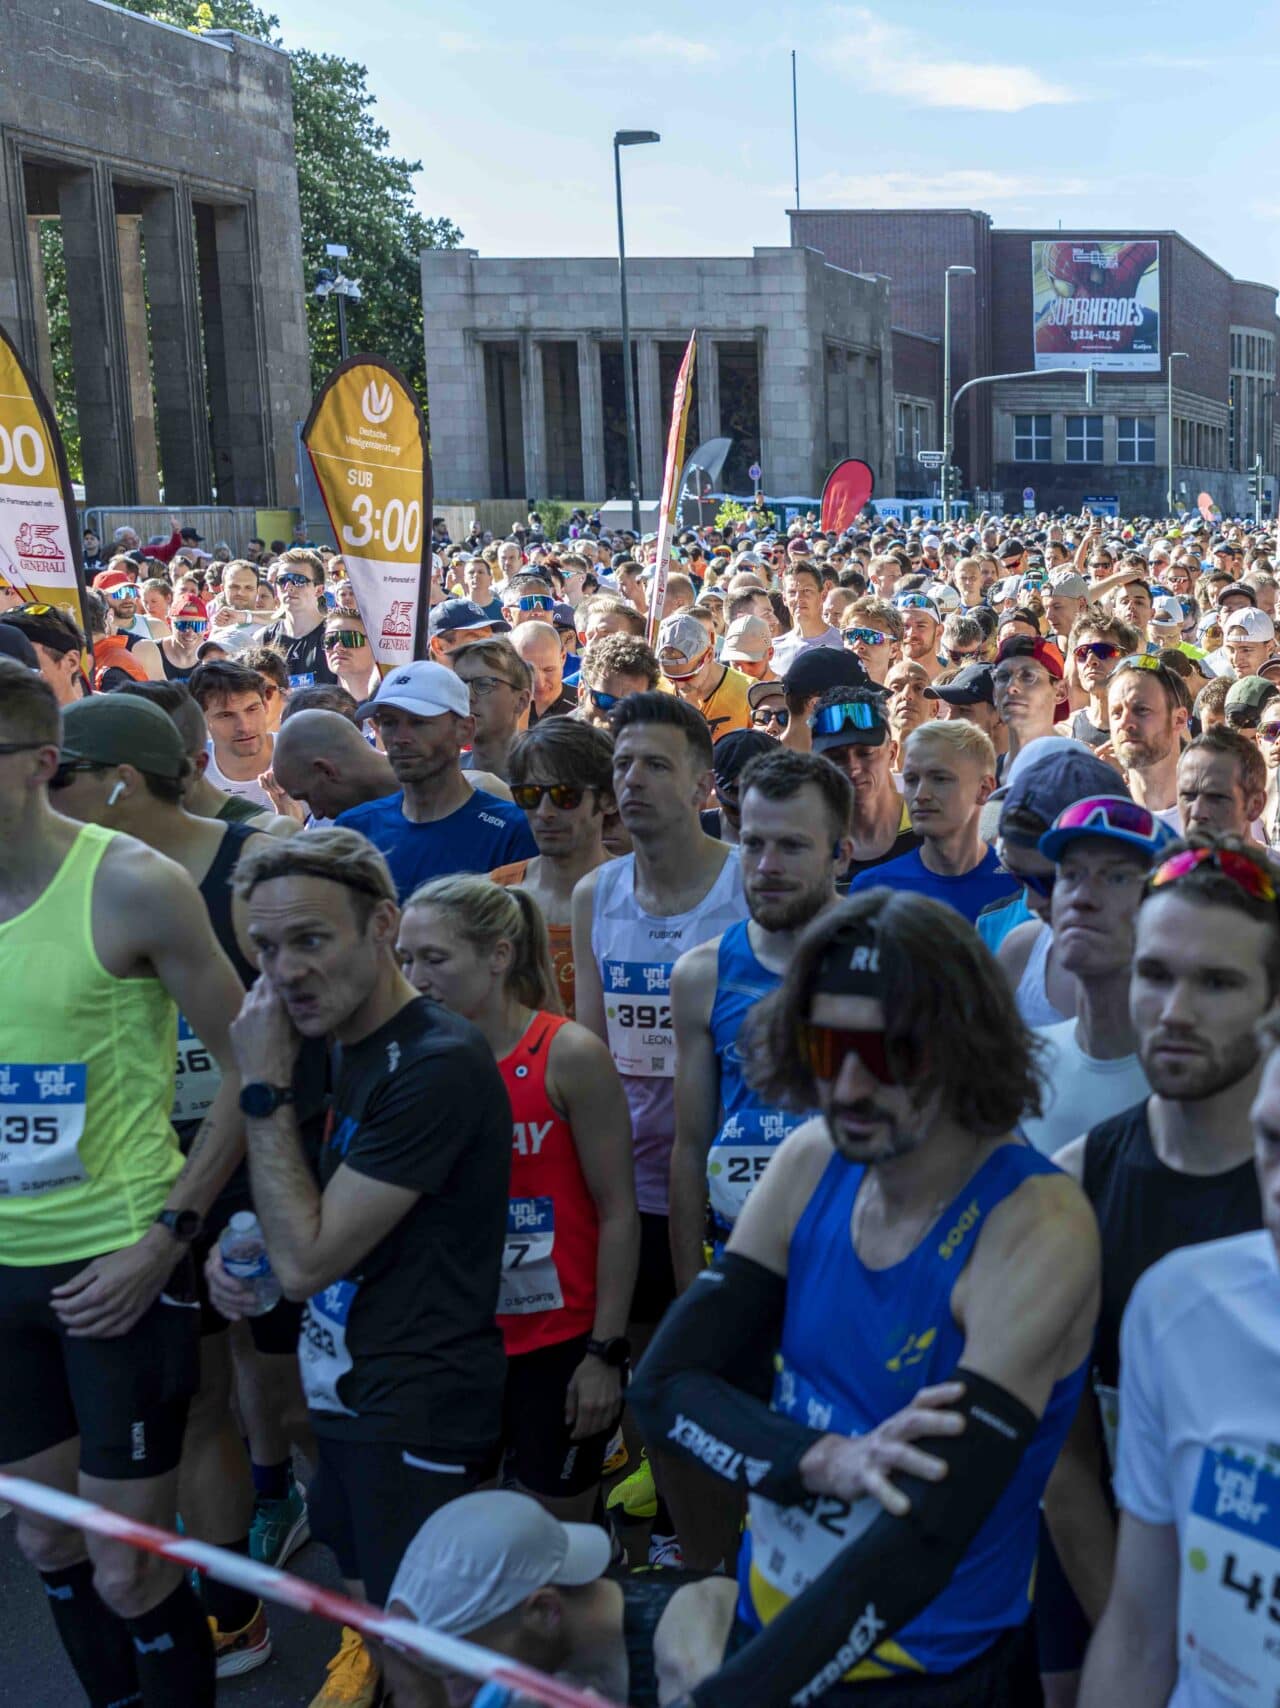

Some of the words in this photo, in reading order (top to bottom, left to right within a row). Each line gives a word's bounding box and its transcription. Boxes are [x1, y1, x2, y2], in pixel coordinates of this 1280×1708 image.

[1048, 297, 1144, 326] SUPERHEROES
[347, 469, 373, 488] SUB
[343, 494, 420, 553] 3:00
[20, 561, 66, 574] GENERALI
[609, 963, 625, 977] uni
[643, 964, 665, 979] uni
[611, 976, 631, 989] per
[642, 1034, 672, 1045] LEON
[34, 1065, 66, 1083] uni
[0, 1081, 20, 1096] er
[40, 1081, 77, 1099] per
[759, 1111, 784, 1127] uni
[0, 1116, 58, 1144] 35
[512, 1119, 553, 1155] AY
[509, 1201, 536, 1216] uni
[515, 1212, 546, 1229] per
[507, 1243, 530, 1269] 7
[1214, 1463, 1258, 1501] uni
[1215, 1494, 1269, 1524] per
